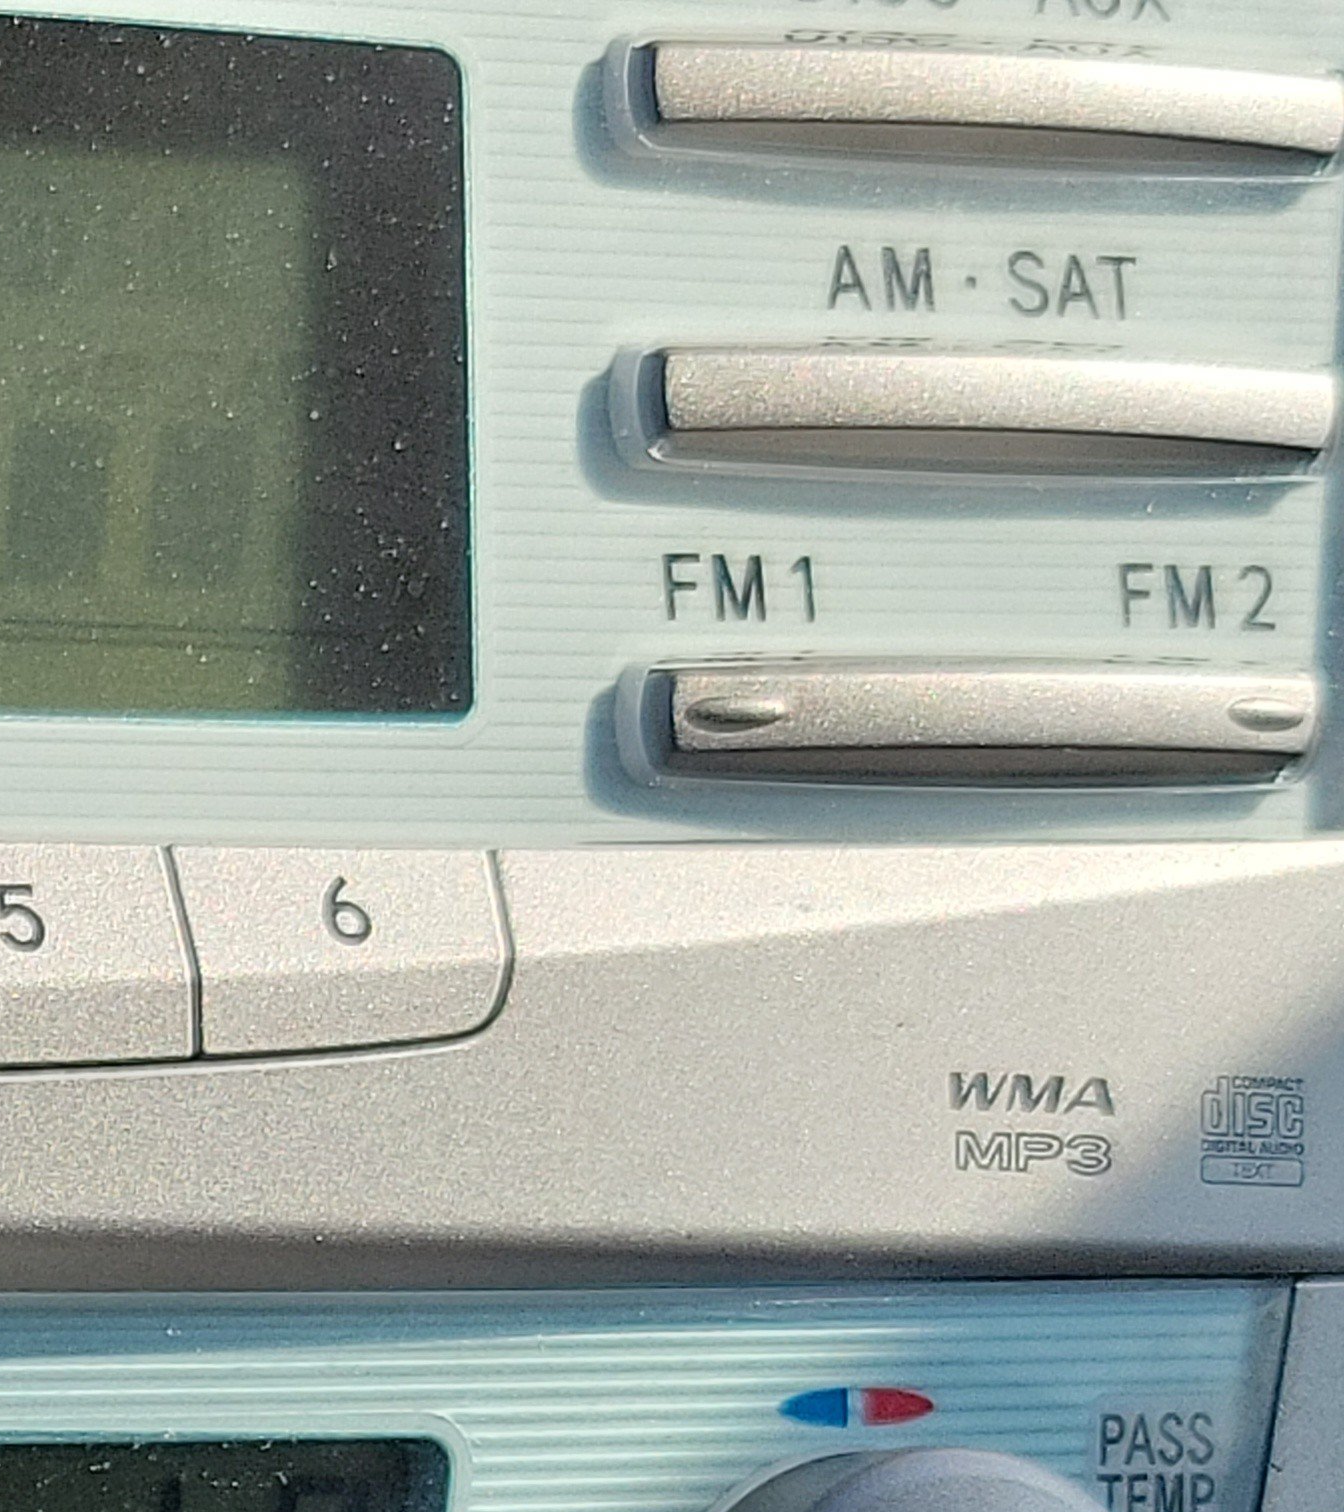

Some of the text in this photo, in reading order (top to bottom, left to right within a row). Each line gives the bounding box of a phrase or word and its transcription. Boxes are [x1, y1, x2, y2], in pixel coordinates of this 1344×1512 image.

[321, 876, 374, 947] 6
[947, 1072, 1116, 1116] WMA
[954, 1130, 1113, 1177] MP3
[1099, 1411, 1215, 1466] PASS
